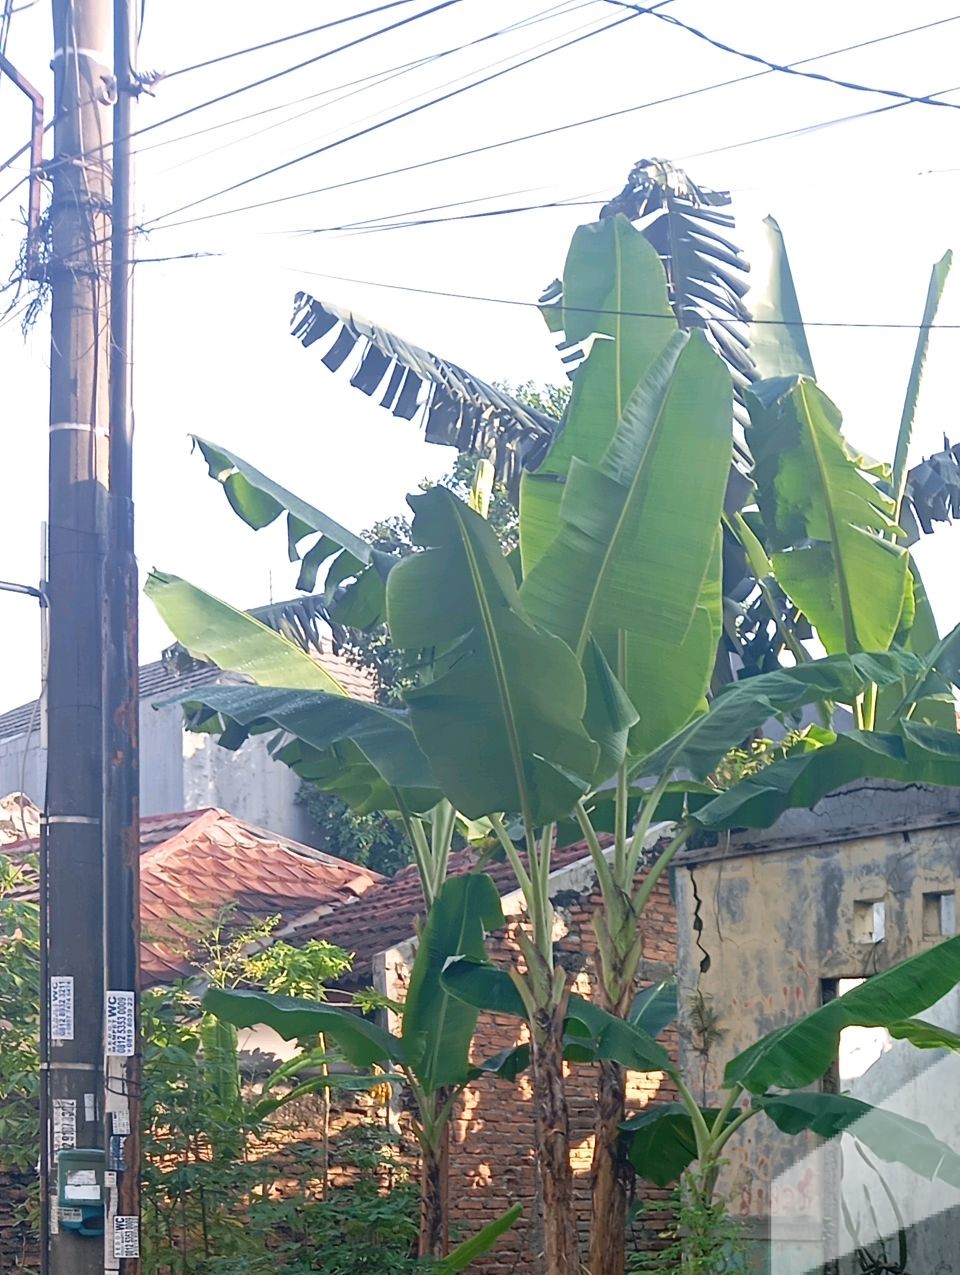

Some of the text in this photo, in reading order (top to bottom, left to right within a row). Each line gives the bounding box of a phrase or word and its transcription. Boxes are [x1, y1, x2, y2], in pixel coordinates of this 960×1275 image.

[52, 982, 58, 1001] WC
[108, 996, 117, 1017] WC
[117, 1016, 126, 1034] 5353
[117, 1035, 126, 1054] 0812
[115, 1218, 125, 1230] WC
